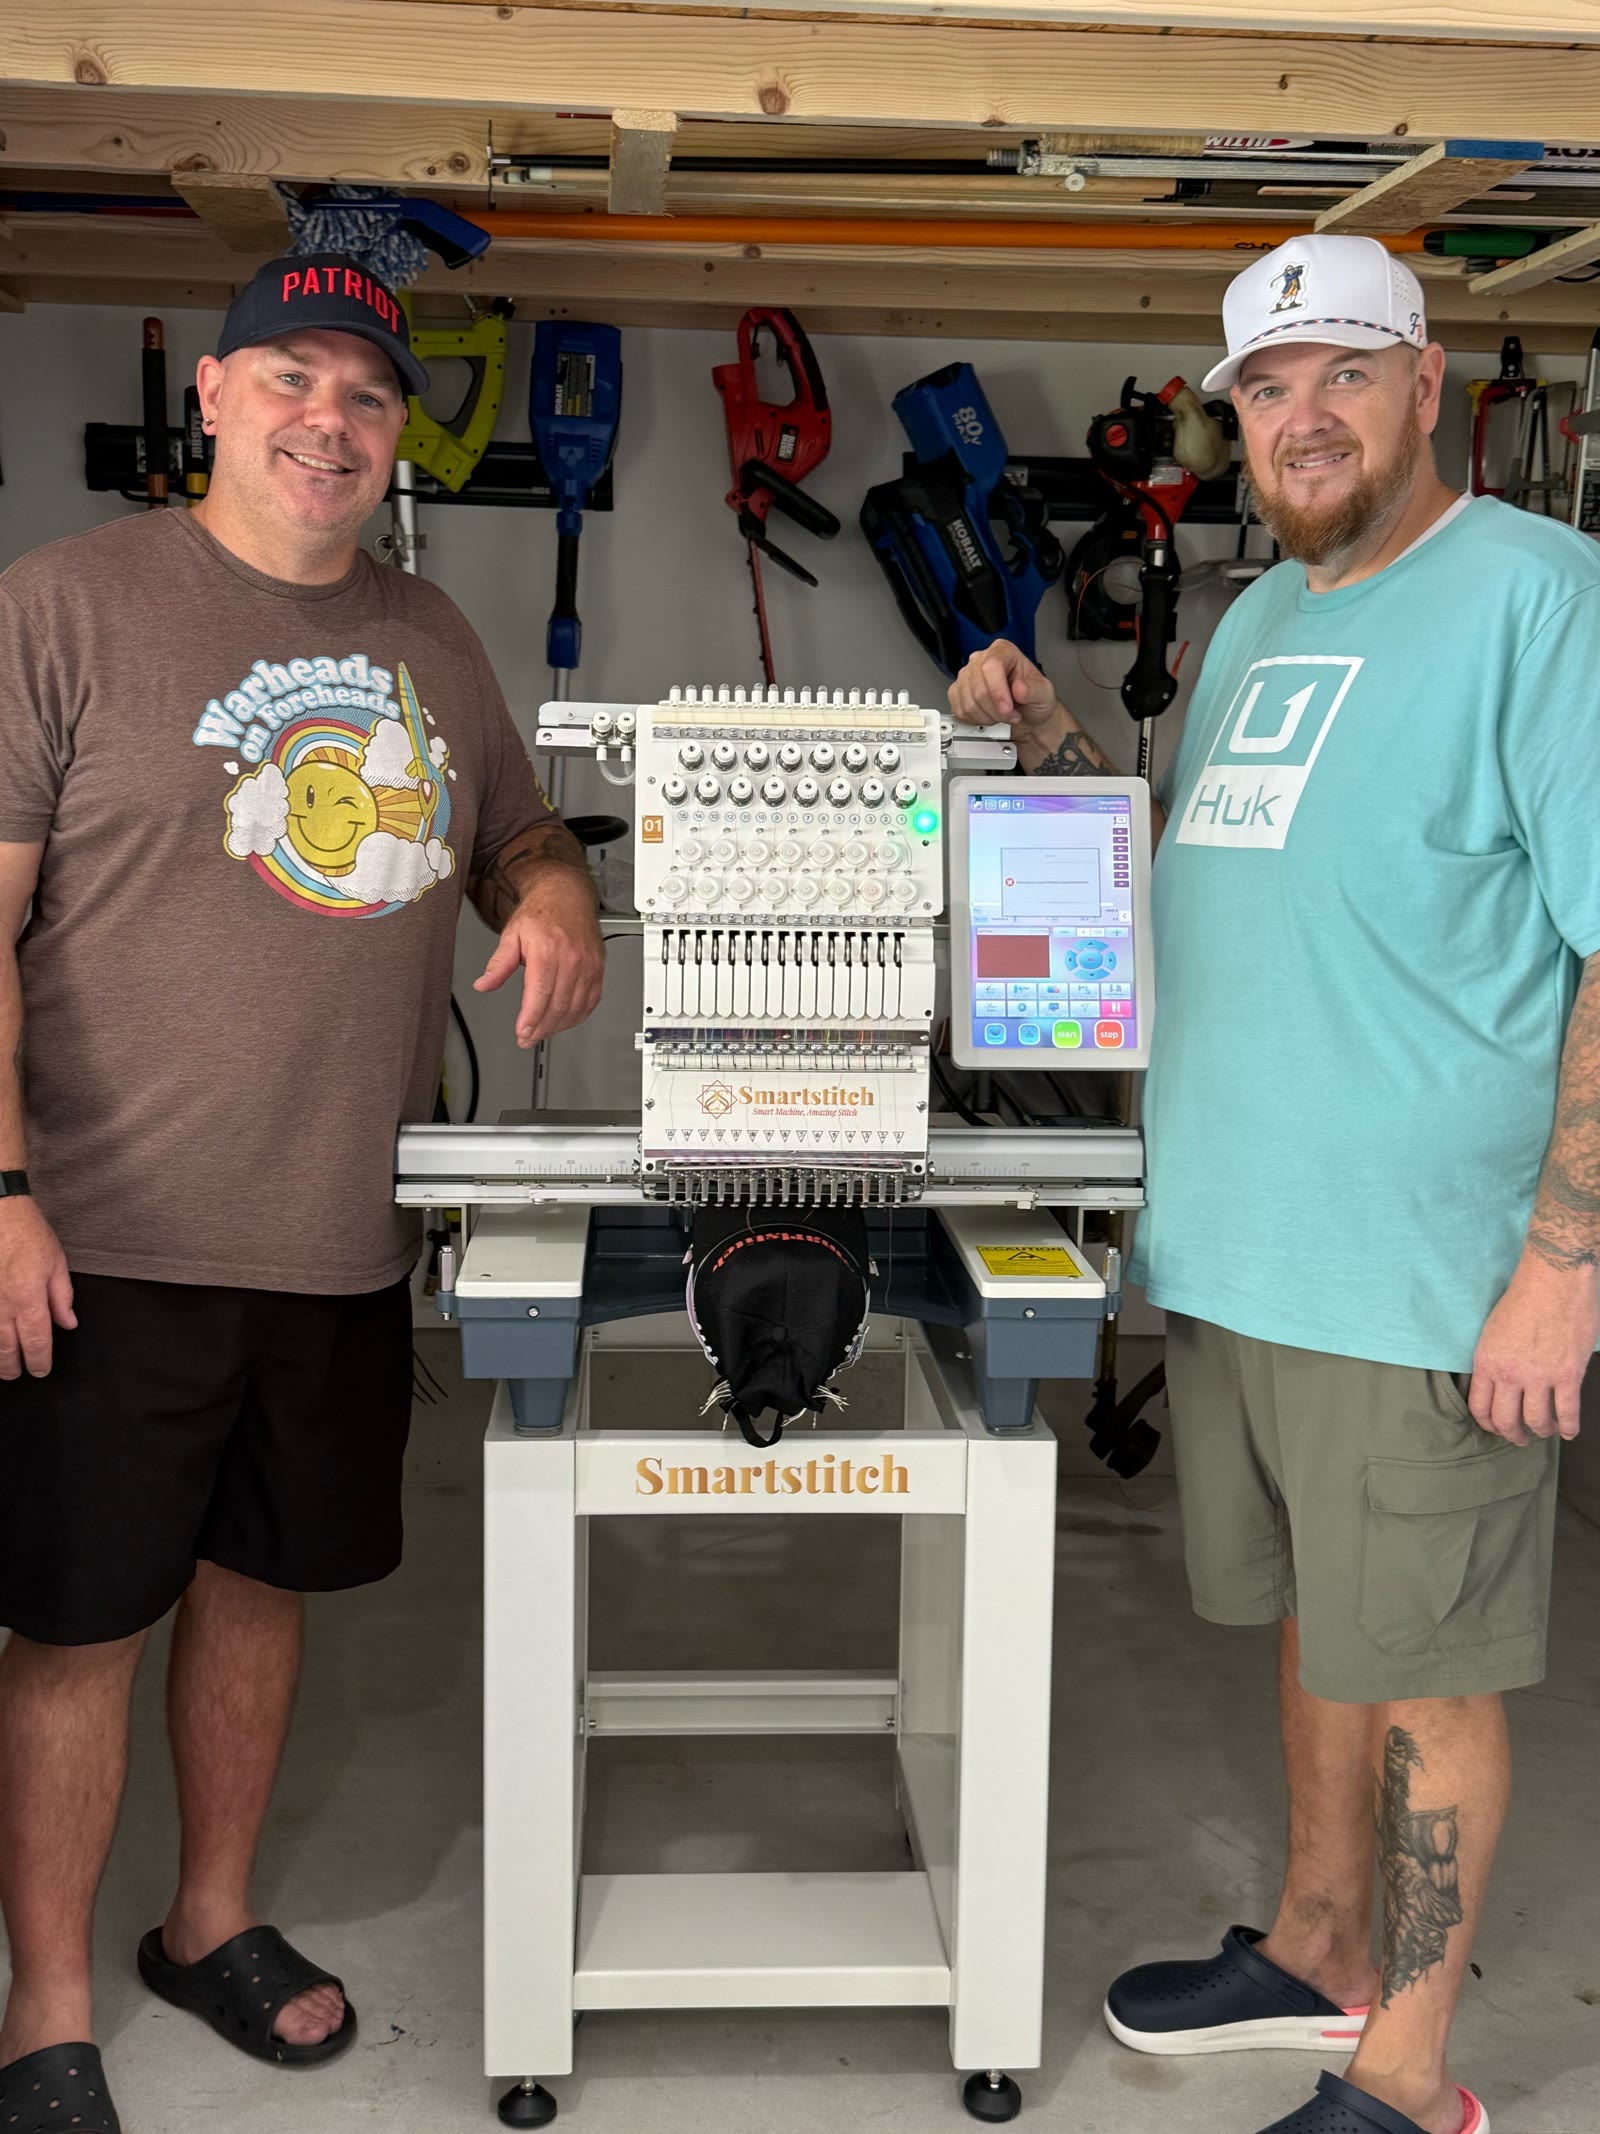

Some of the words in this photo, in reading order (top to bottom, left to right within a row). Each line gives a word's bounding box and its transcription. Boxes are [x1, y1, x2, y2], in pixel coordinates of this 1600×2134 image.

[283, 267, 400, 334] PATRIOT
[952, 519, 983, 569] KOBALT
[193, 654, 393, 748] Warheads
[240, 724, 272, 763] on
[256, 684, 401, 731] Foreheads
[644, 819, 662, 832] 01
[1100, 1031, 1119, 1040] stop
[738, 1086, 875, 1106] Smartstitch
[752, 1107, 774, 1116] Smart
[806, 1108, 837, 1118] Amazing
[838, 1108, 858, 1116] Stitch
[635, 1453, 911, 1495] Smartstitch
